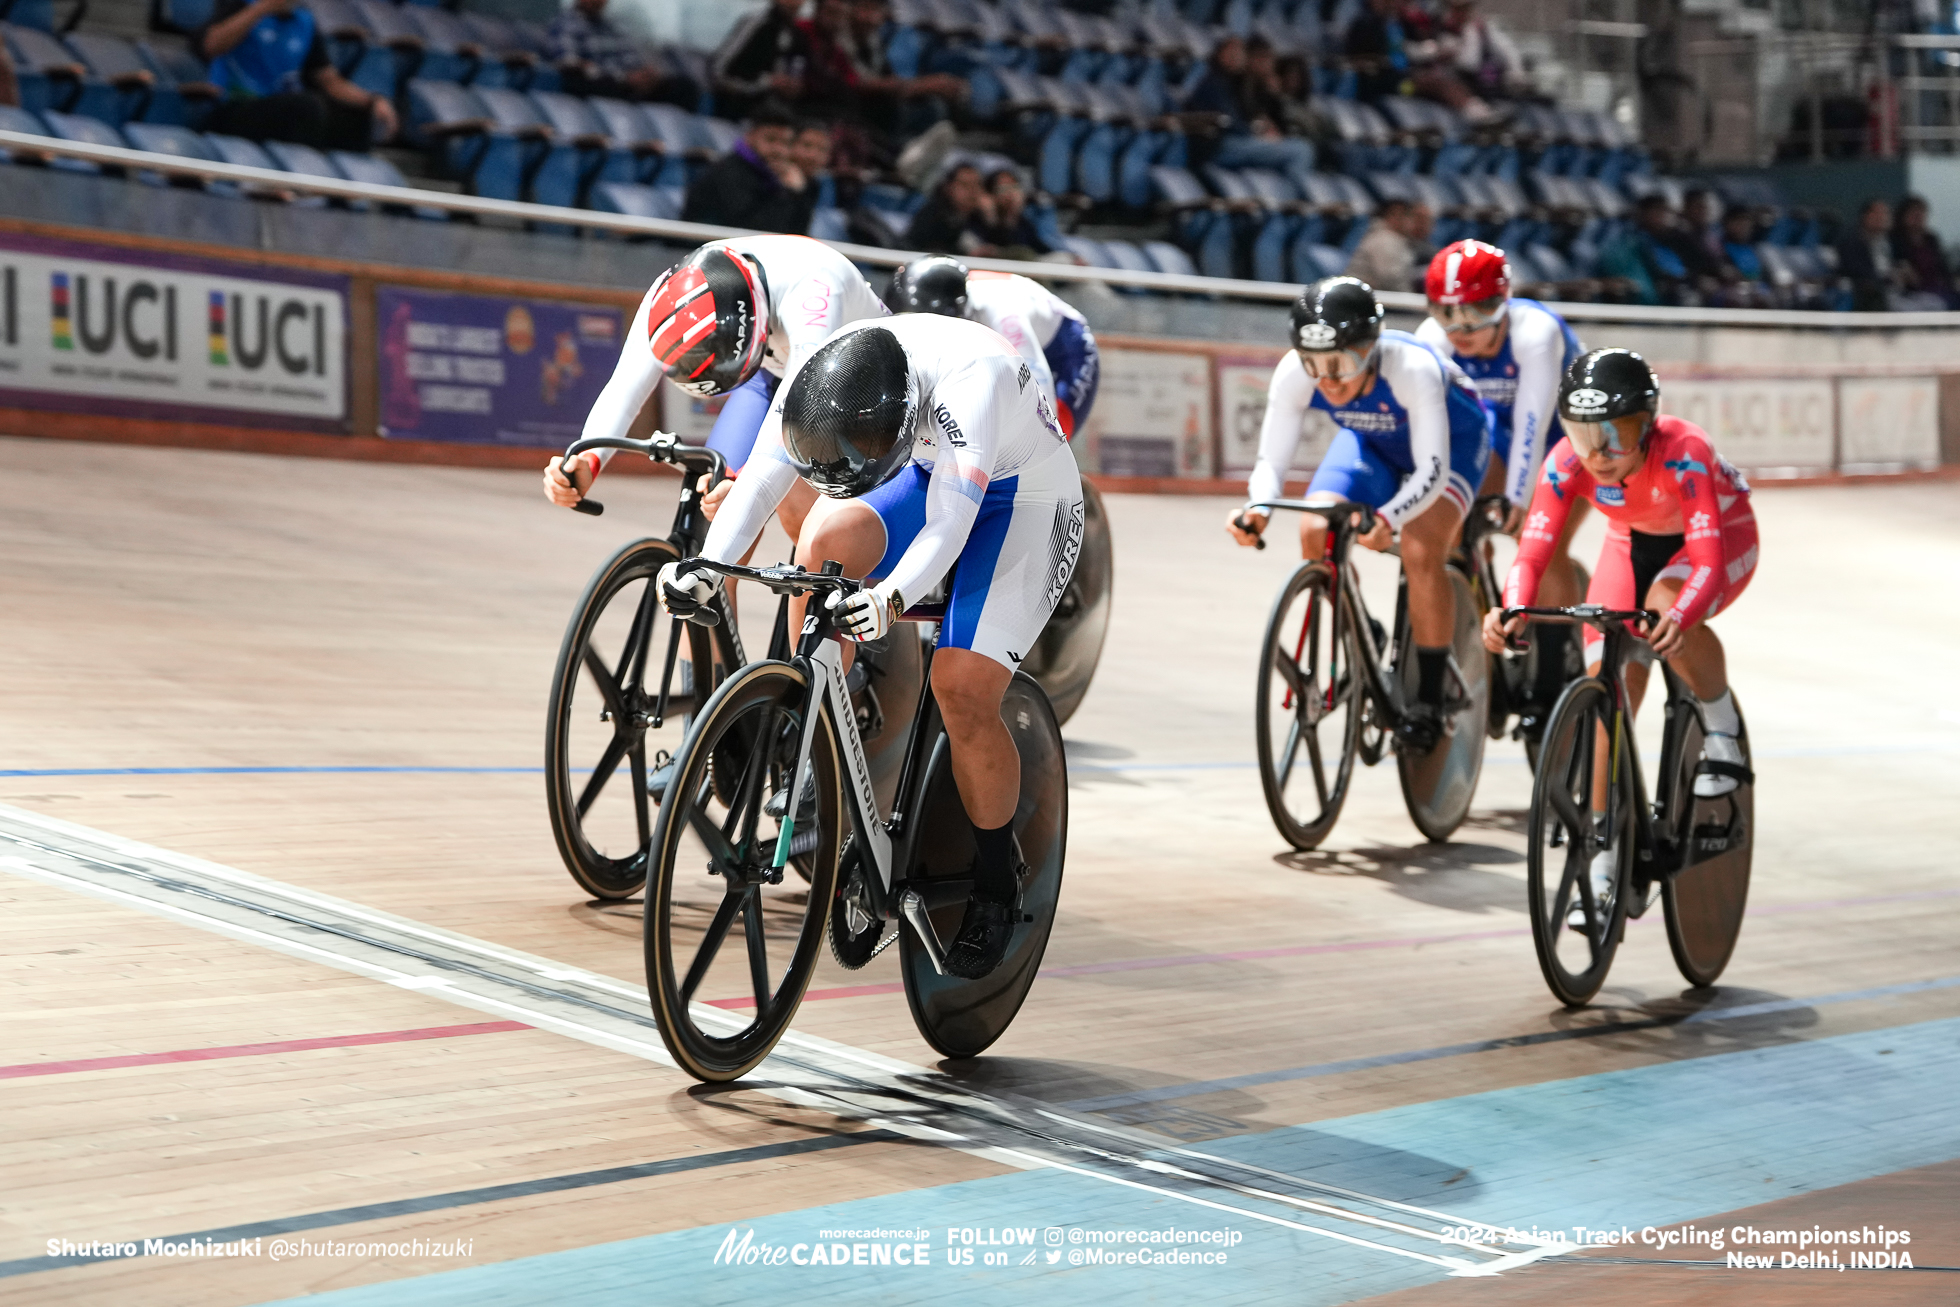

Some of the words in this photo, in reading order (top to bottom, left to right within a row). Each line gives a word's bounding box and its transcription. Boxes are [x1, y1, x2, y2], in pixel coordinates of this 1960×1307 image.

[76, 274, 178, 362] UCI
[231, 293, 326, 377] UCI
[732, 300, 747, 361] JAPAN
[934, 402, 967, 448] KOREA
[1046, 500, 1084, 612] KOREA
[834, 660, 881, 837] BRIDGESTONE
